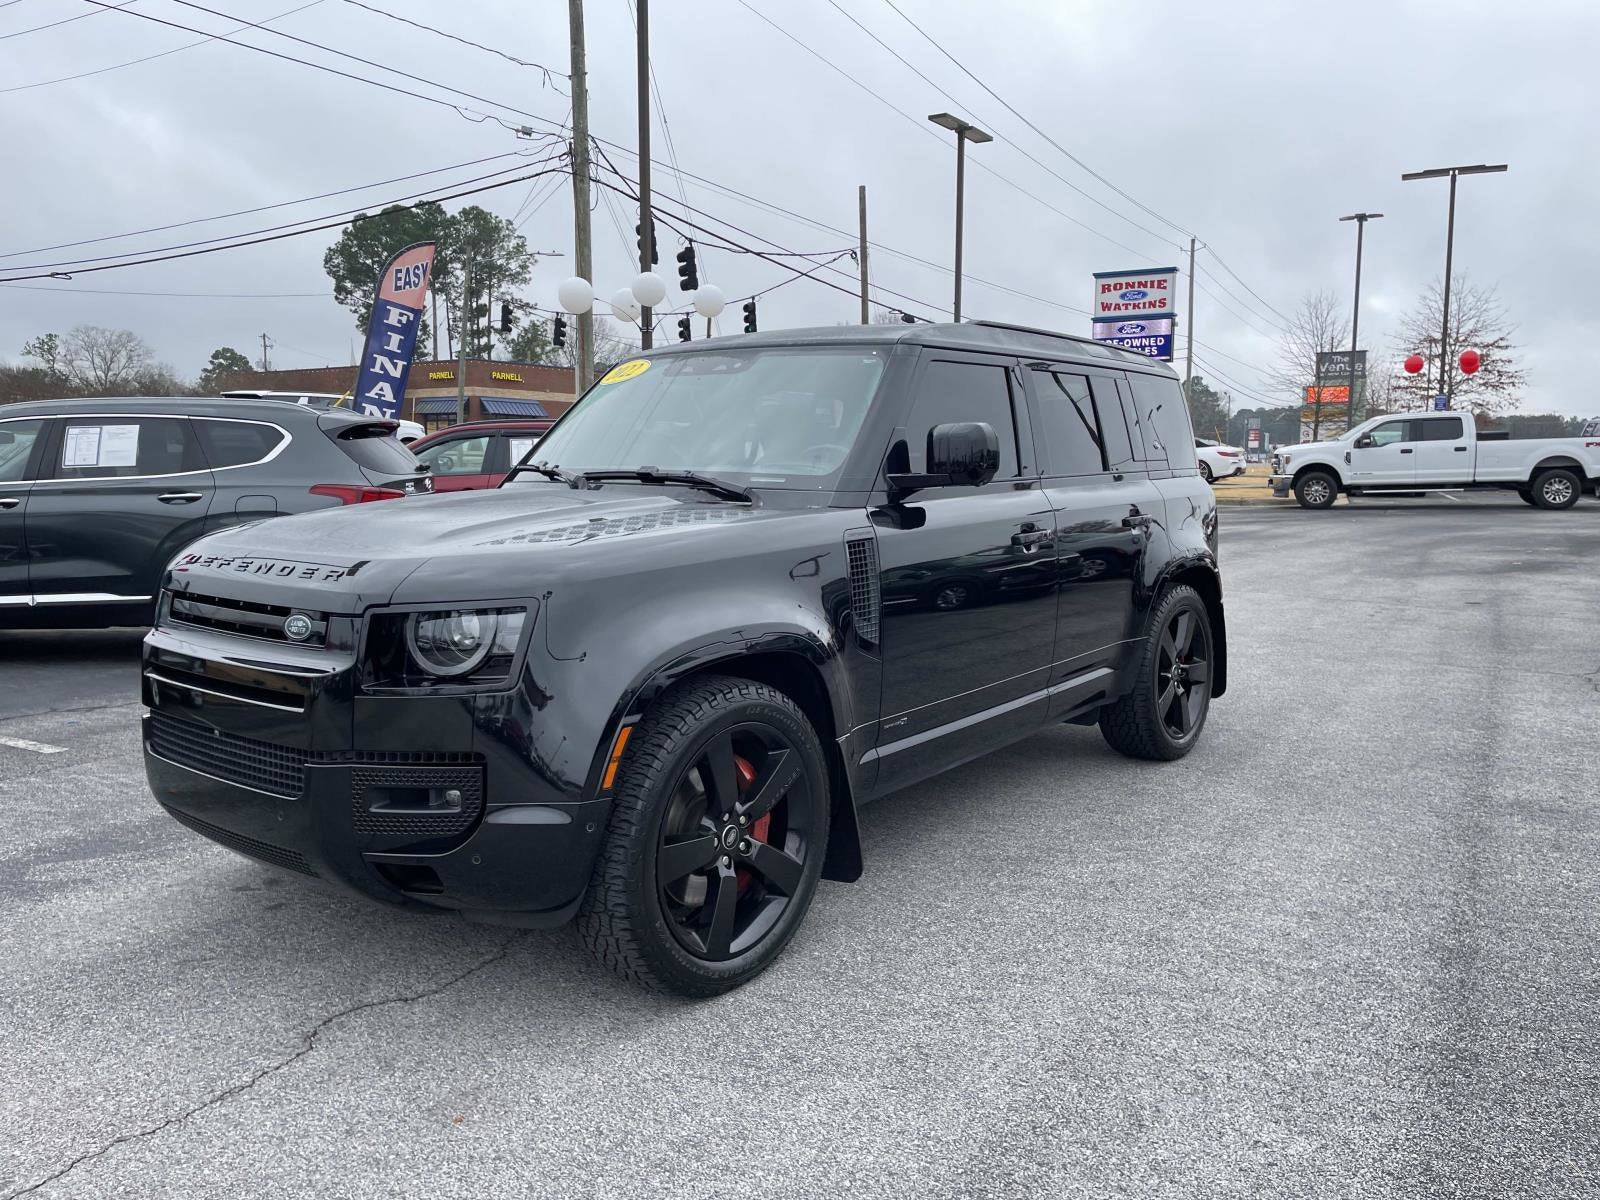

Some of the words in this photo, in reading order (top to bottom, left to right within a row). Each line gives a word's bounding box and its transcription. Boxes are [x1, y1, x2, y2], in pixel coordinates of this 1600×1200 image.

[394, 261, 430, 292] EASY
[1101, 279, 1168, 294] RONNIE
[1124, 291, 1143, 300] Ford
[1101, 298, 1167, 312] WATKINS
[1121, 323, 1143, 334] Ford
[1332, 355, 1350, 363] The
[429, 371, 455, 380] PARNELL
[492, 371, 523, 382] PARNELL
[186, 553, 346, 582] DEFENDER
